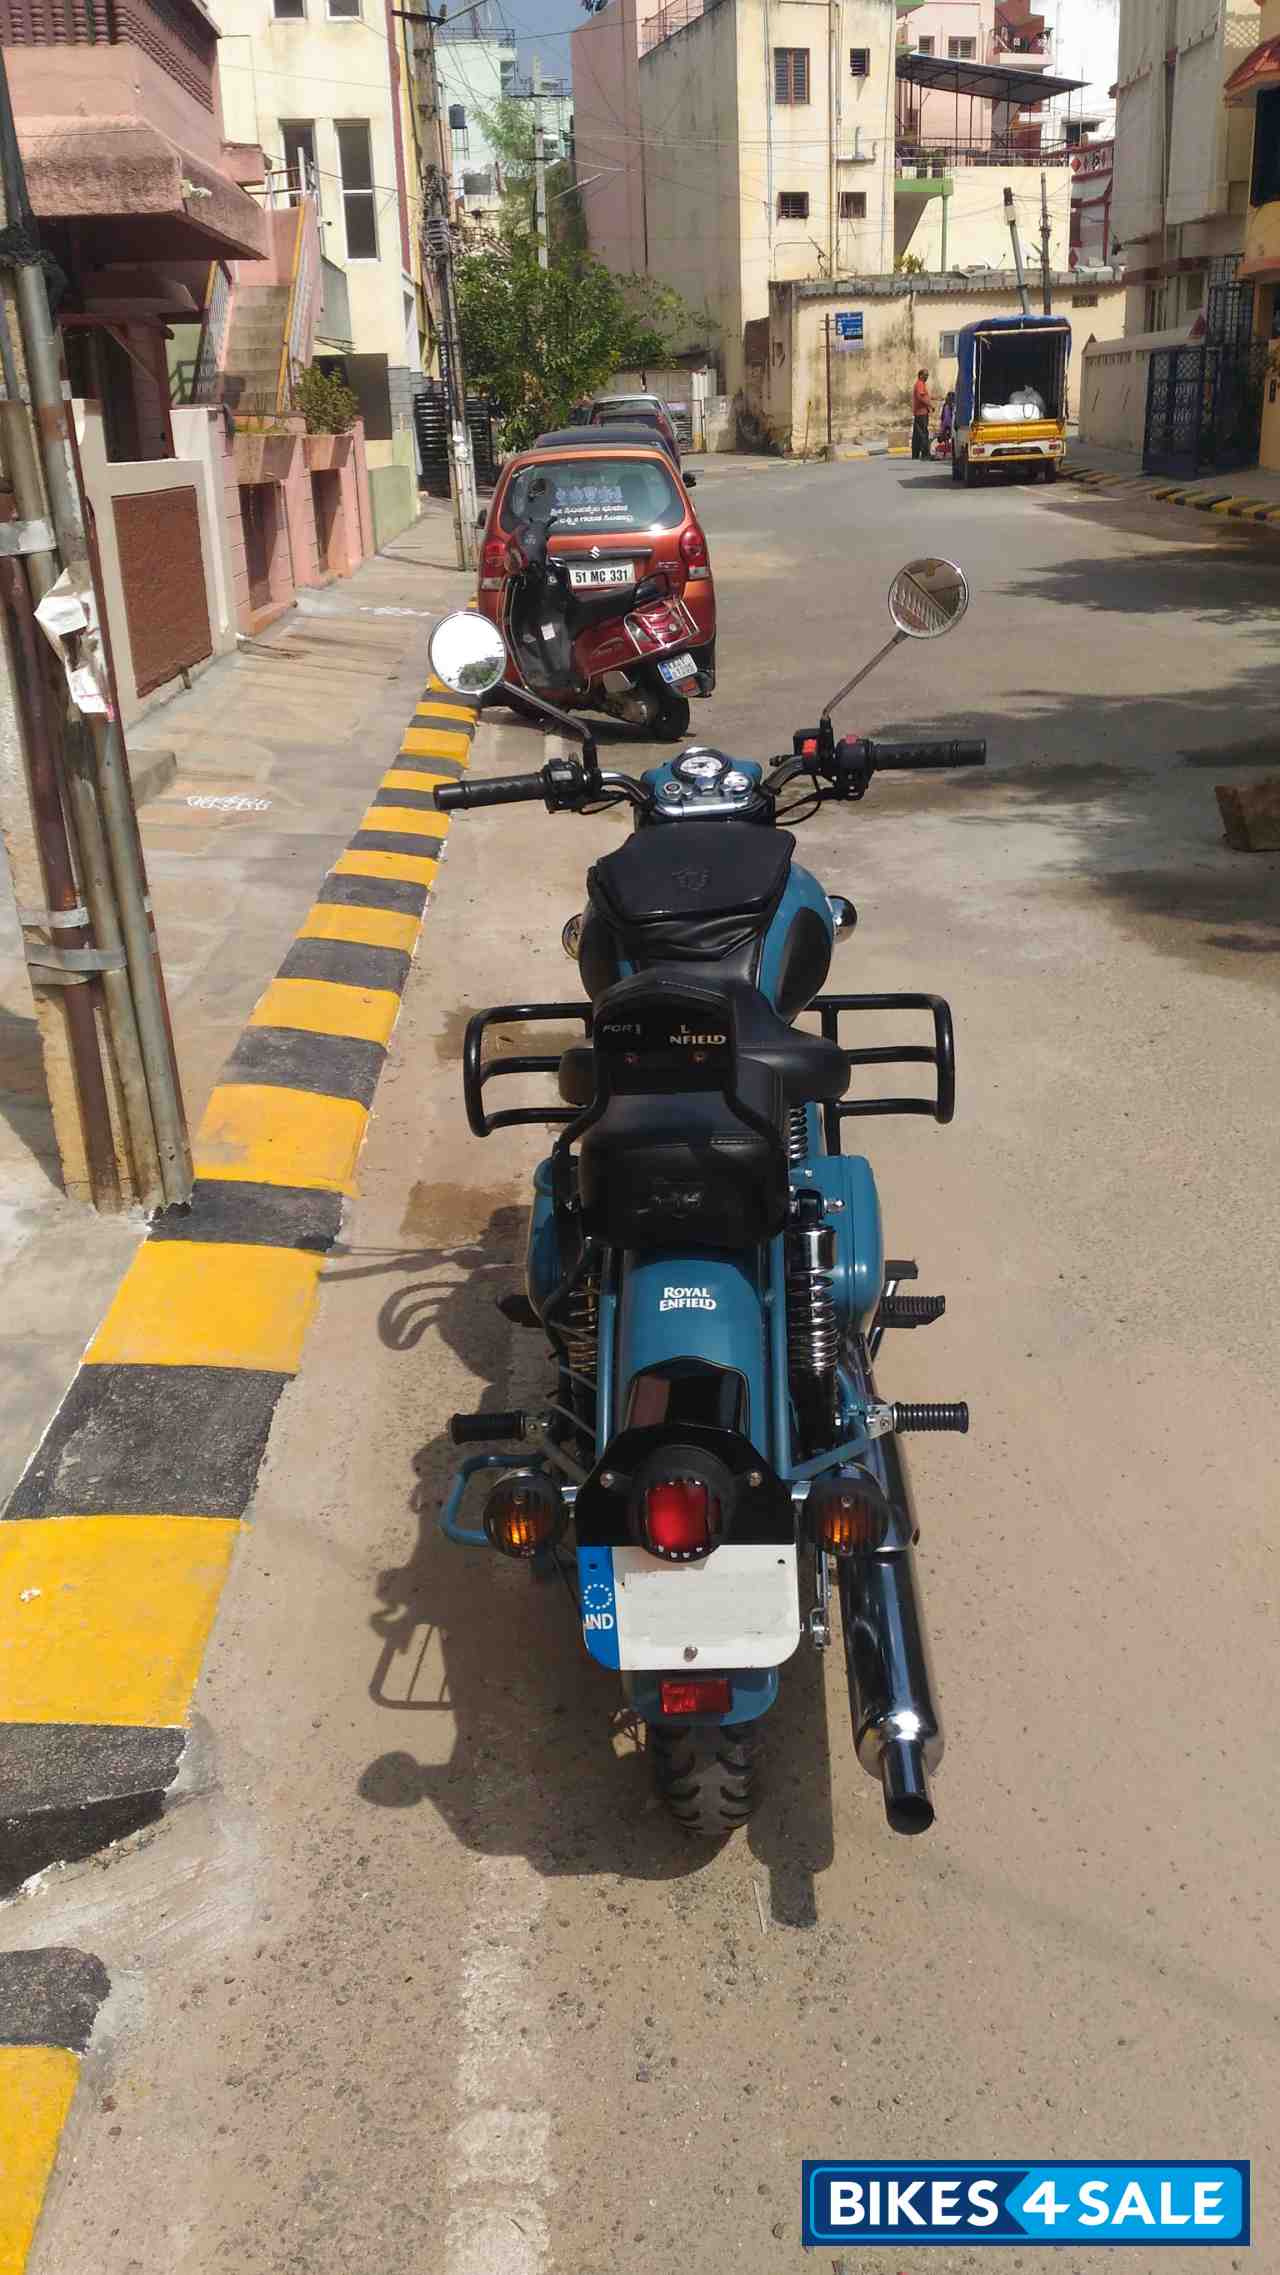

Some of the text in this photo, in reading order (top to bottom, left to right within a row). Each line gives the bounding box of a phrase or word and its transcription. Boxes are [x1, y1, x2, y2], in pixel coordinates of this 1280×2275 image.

[575, 569, 628, 583] 51 MC 331
[664, 1286, 710, 1298] ROYAL
[659, 1298, 717, 1311] ENFIELD
[583, 1613, 614, 1630] IND
